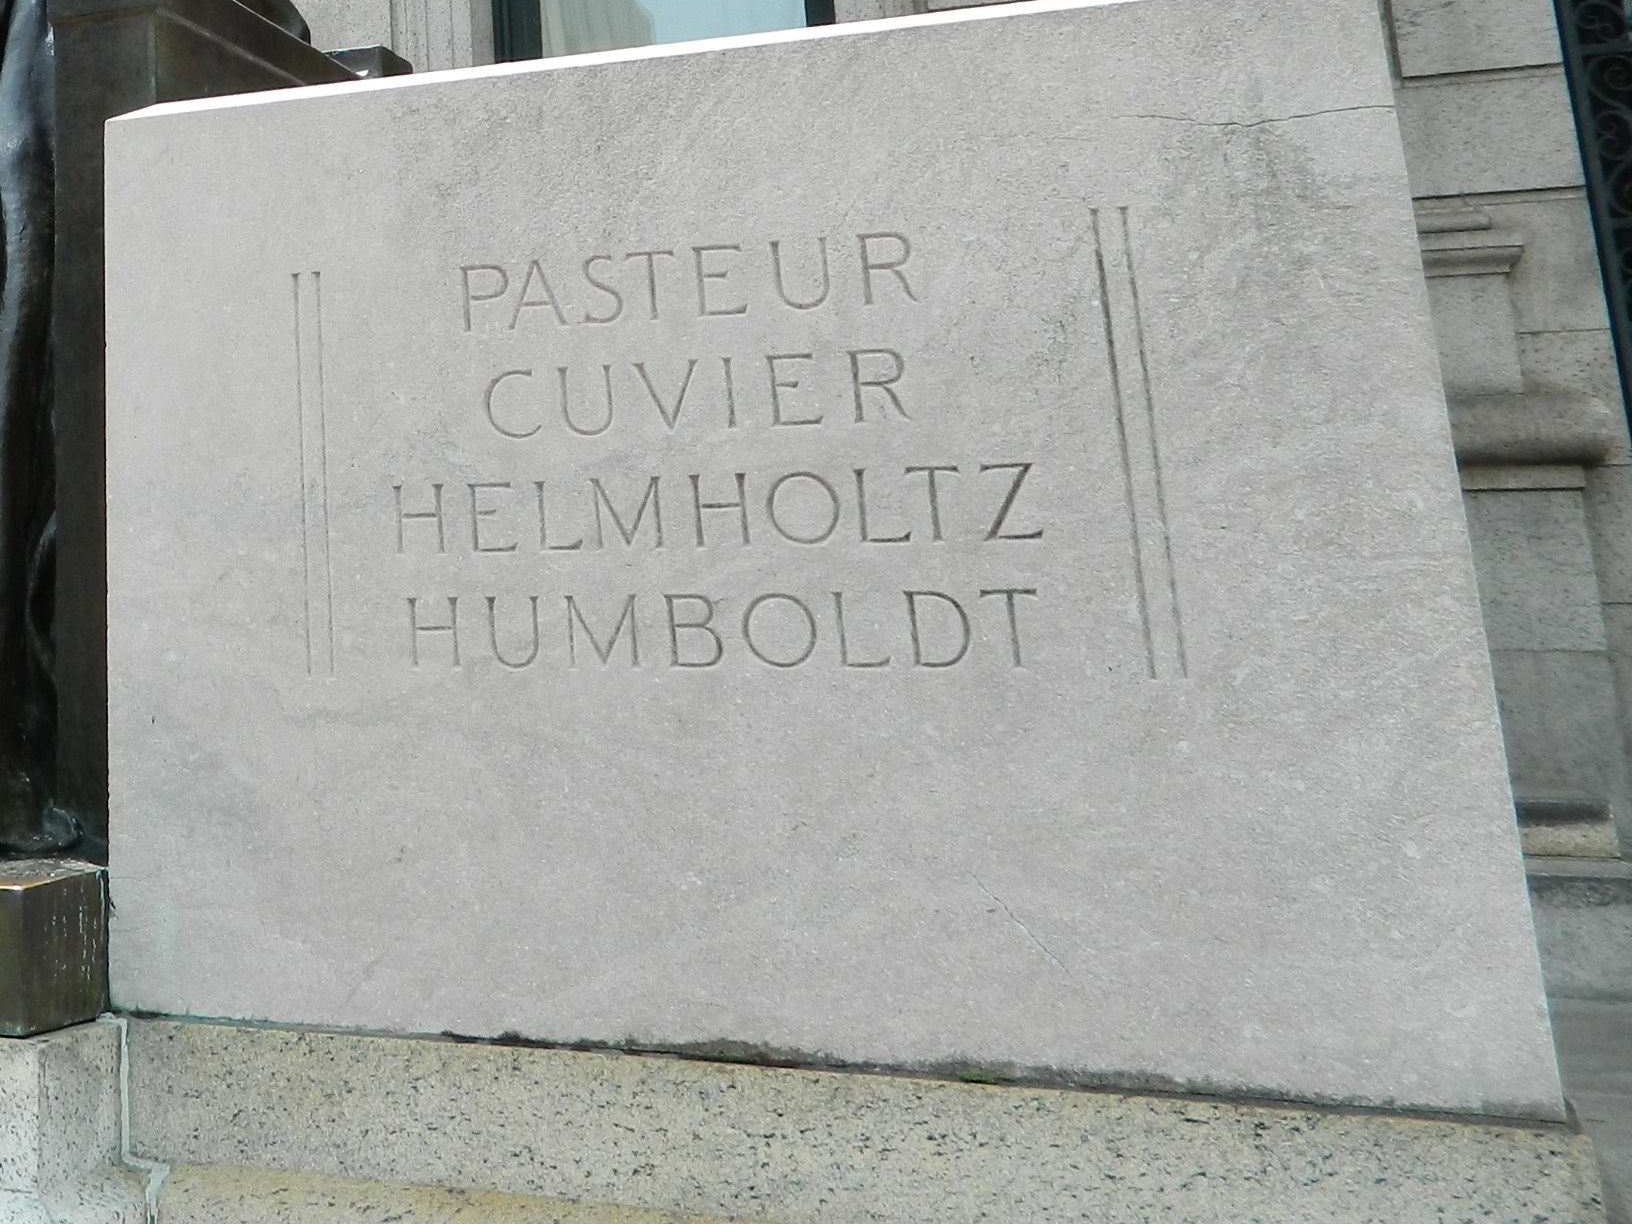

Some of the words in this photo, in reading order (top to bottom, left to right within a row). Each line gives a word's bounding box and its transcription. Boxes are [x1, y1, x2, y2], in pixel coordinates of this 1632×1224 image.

[459, 231, 920, 333] PASTEUR
[486, 348, 911, 440] CUVIER
[391, 462, 1046, 555] HELMHOLTZ
[404, 588, 1037, 672] HUMBOLDT
